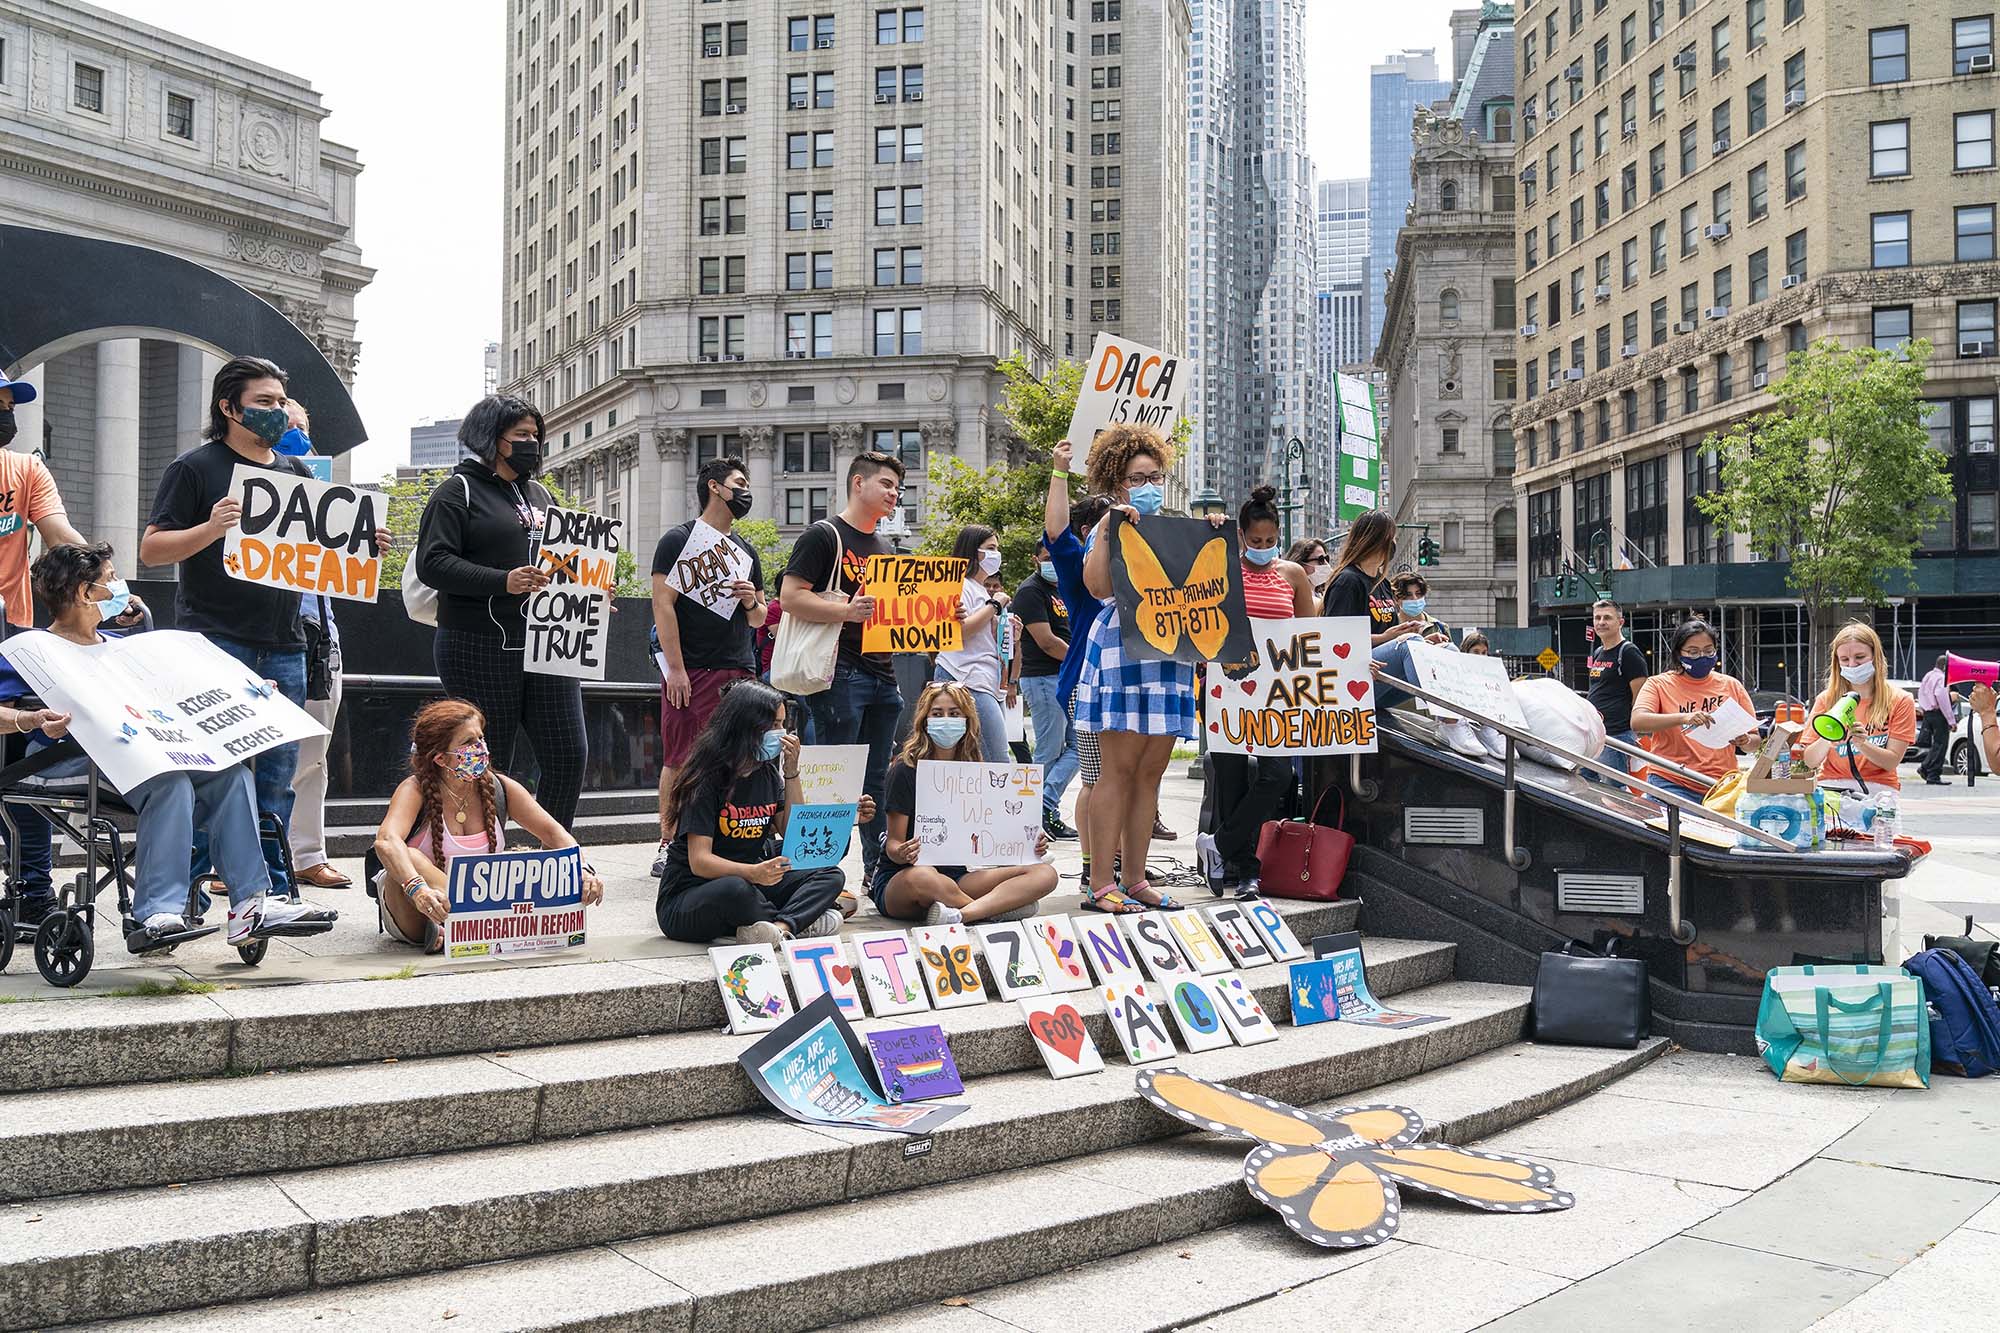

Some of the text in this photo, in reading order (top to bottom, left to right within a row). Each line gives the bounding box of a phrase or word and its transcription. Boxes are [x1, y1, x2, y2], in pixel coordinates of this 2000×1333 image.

[1094, 345, 1177, 401] DACA
[1109, 398, 1173, 428] IS NOT
[240, 477, 380, 558] DACA
[543, 507, 623, 553] DREAMS
[240, 538, 378, 599] DREAM
[581, 558, 615, 591] WILL
[866, 557, 968, 585] CITIZENSHIP
[898, 583, 918, 596] FOR
[1144, 577, 1224, 606] TEXT PATHWAY
[532, 592, 603, 626] COME
[529, 625, 599, 667] TRUE
[890, 621, 953, 650] NOW!!
[1266, 632, 1322, 672] WE
[177, 688, 232, 716] RIGHTS
[1265, 669, 1338, 708] ARE
[1679, 696, 1723, 713] WE ARE
[197, 704, 257, 734] RIGHTS
[1221, 706, 1377, 748] UNDENIABLE
[165, 726, 284, 766] HUMAN RIGHTS
[934, 766, 983, 803] United
[739, 817, 770, 827] STUDENT
[963, 799, 993, 825] We
[980, 830, 1025, 864] Dream
[456, 853, 579, 904] I SUPPORT
[512, 904, 533, 914] THE
[451, 916, 538, 943] IMMIGRATION
[541, 910, 584, 935] REFORM
[1040, 1013, 1084, 1046] FOR
[782, 1036, 826, 1084] LIVES ARE
[788, 1047, 839, 1100] ON THE LINE
